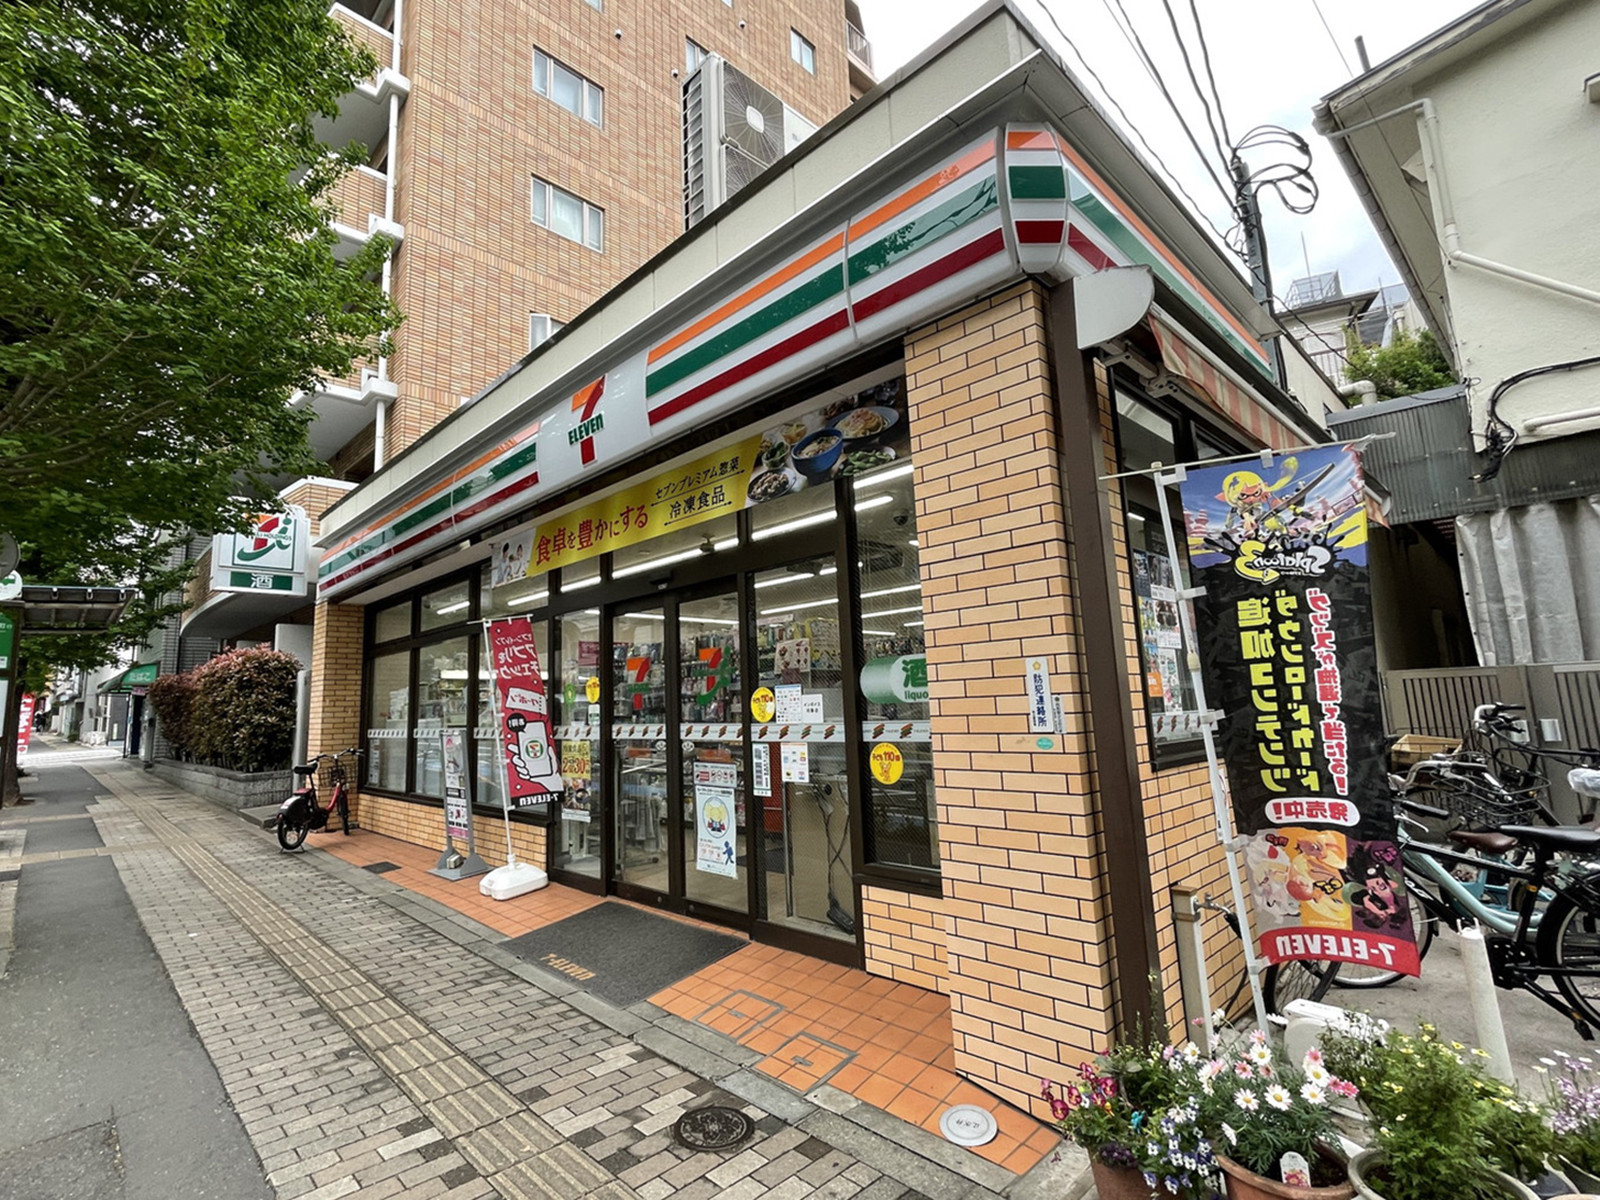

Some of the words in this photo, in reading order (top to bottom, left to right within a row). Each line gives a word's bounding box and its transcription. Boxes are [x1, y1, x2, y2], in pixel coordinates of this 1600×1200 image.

[656, 456, 740, 499] セブンプレミアム惣菜
[670, 485, 725, 519] 冷凍食品
[536, 505, 649, 566] 食卓を豊かにする
[250, 572, 274, 588] 酒
[902, 658, 929, 688] 酒
[904, 690, 930, 701] liquo
